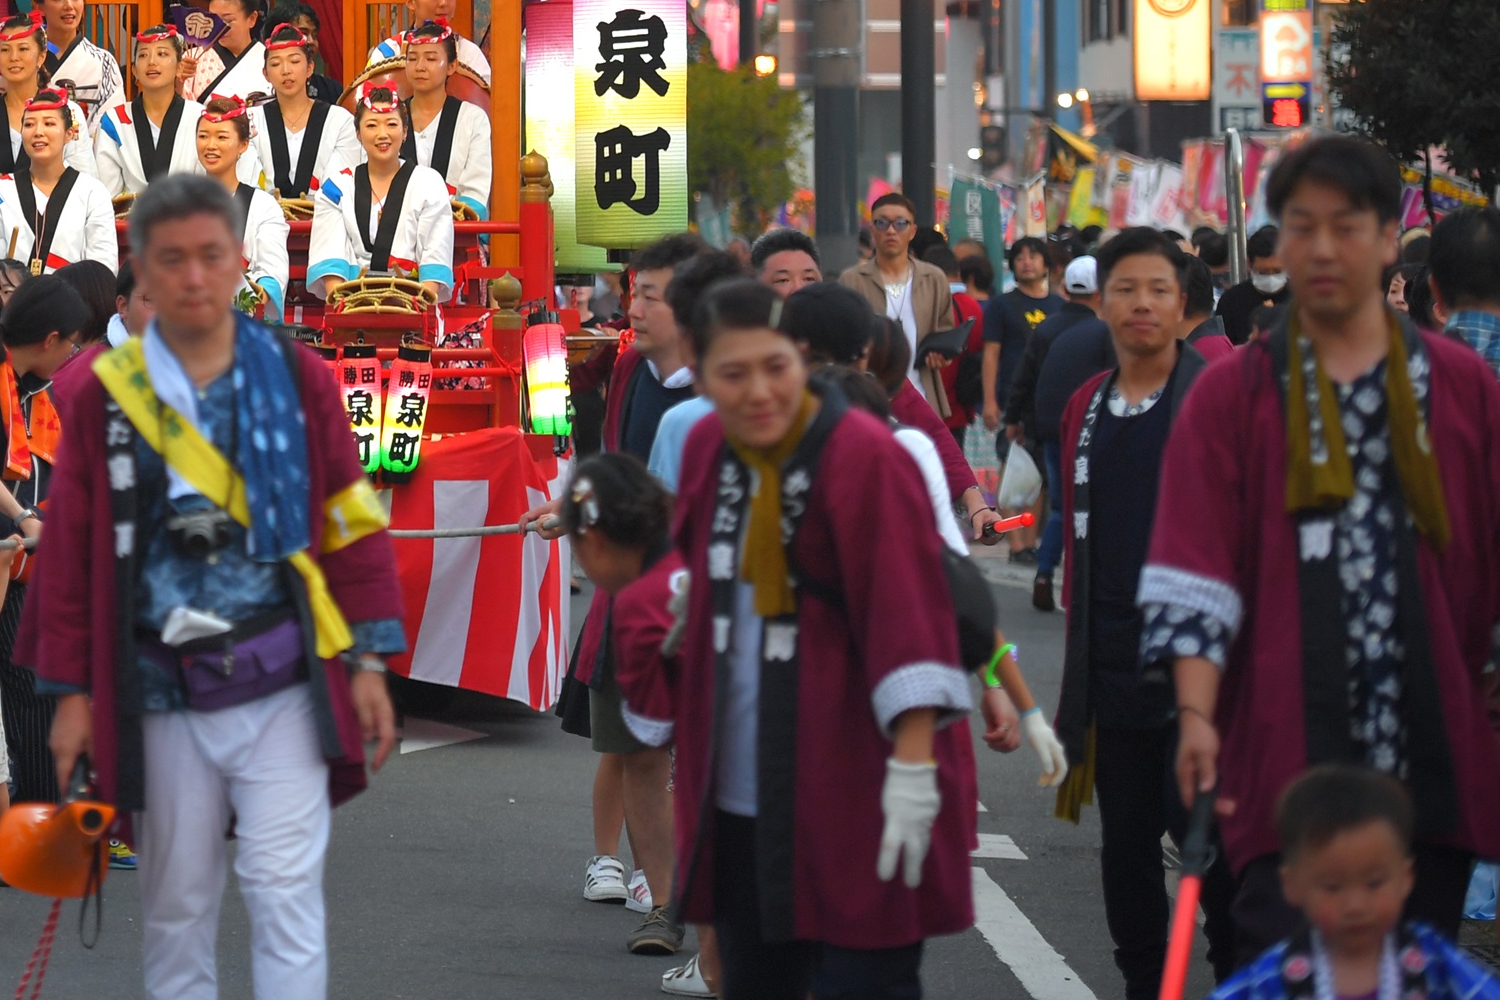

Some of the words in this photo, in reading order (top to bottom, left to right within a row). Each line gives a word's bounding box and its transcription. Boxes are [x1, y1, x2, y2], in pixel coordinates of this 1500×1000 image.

[594, 9, 671, 216] 泉町
[343, 366, 376, 385] 勝田
[400, 370, 431, 389] 勝田
[388, 393, 426, 466] 泉町
